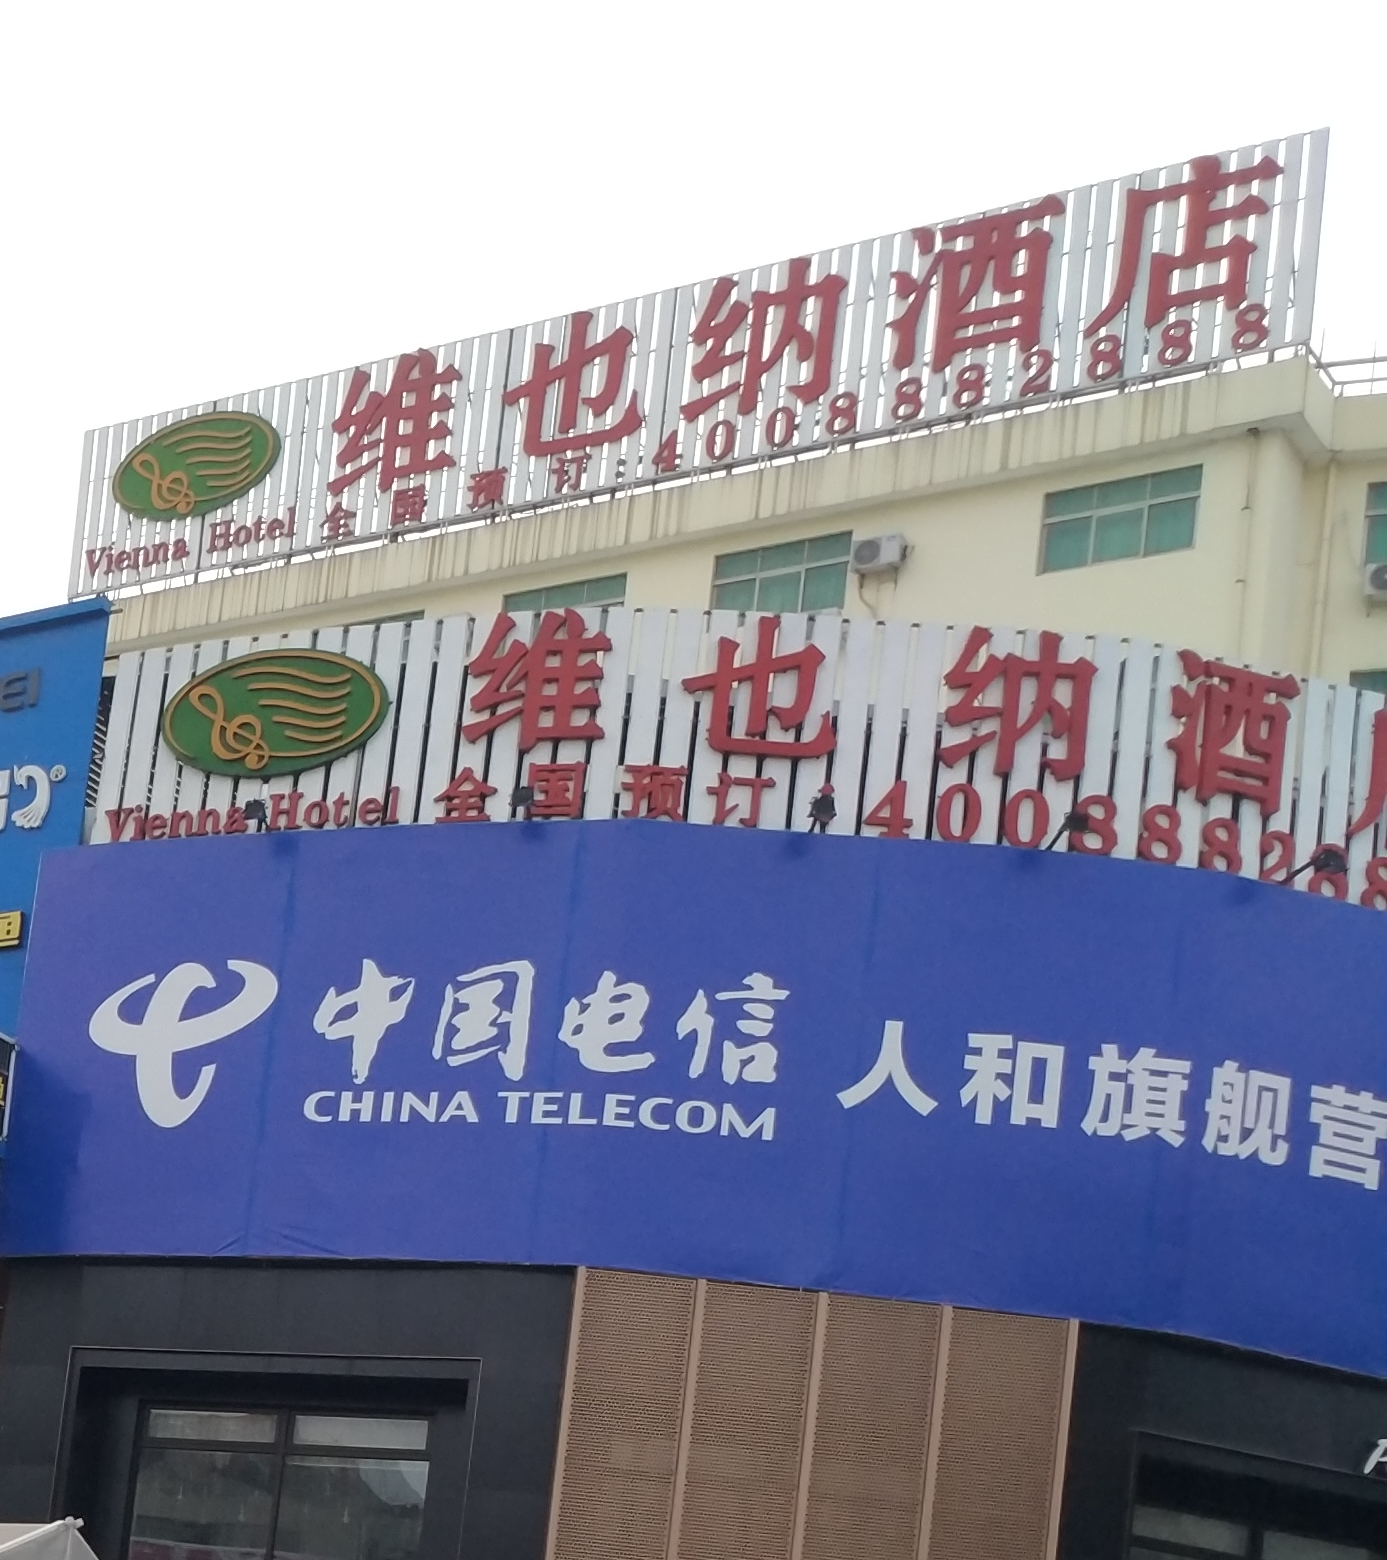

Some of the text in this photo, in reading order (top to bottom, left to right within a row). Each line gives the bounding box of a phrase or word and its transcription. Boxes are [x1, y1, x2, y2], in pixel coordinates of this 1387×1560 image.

[327, 155, 1285, 497] 维也纳酒店
[85, 506, 297, 579] Vienna Hotel
[104, 786, 399, 842] Vienna Hotel
[312, 957, 791, 1085] 中国电信
[303, 1090, 777, 1141] CHINA TELECOM
[836, 1019, 1387, 1191] 人和旗舰营
